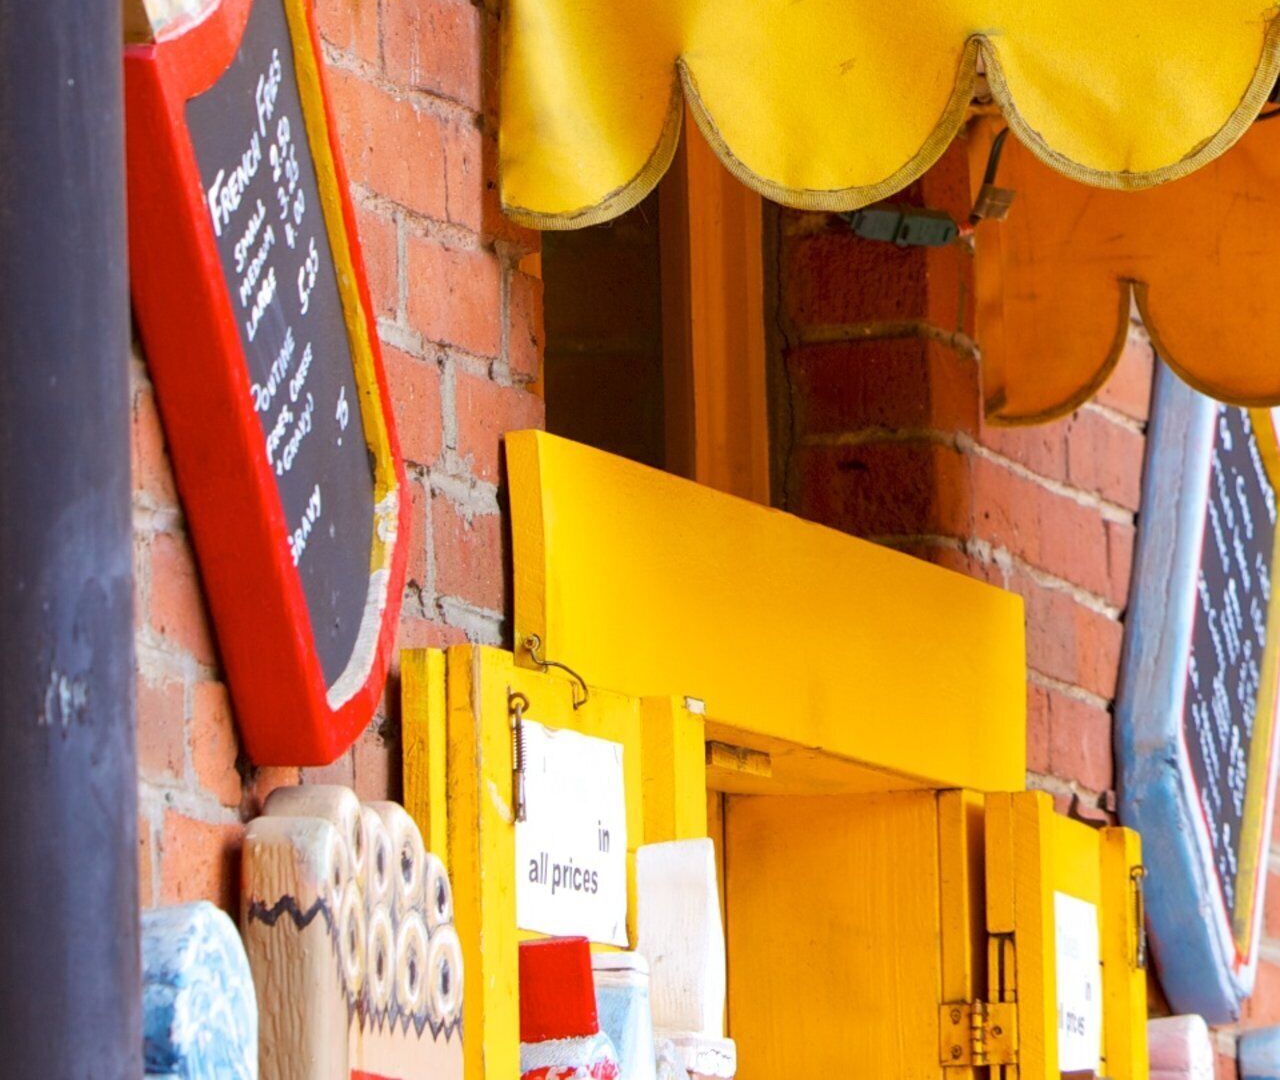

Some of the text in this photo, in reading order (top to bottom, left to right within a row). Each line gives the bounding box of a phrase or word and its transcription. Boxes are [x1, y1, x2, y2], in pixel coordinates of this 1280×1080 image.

[207, 130, 262, 238] FRENCH
[598, 820, 610, 852] in
[529, 852, 598, 895] all prices
